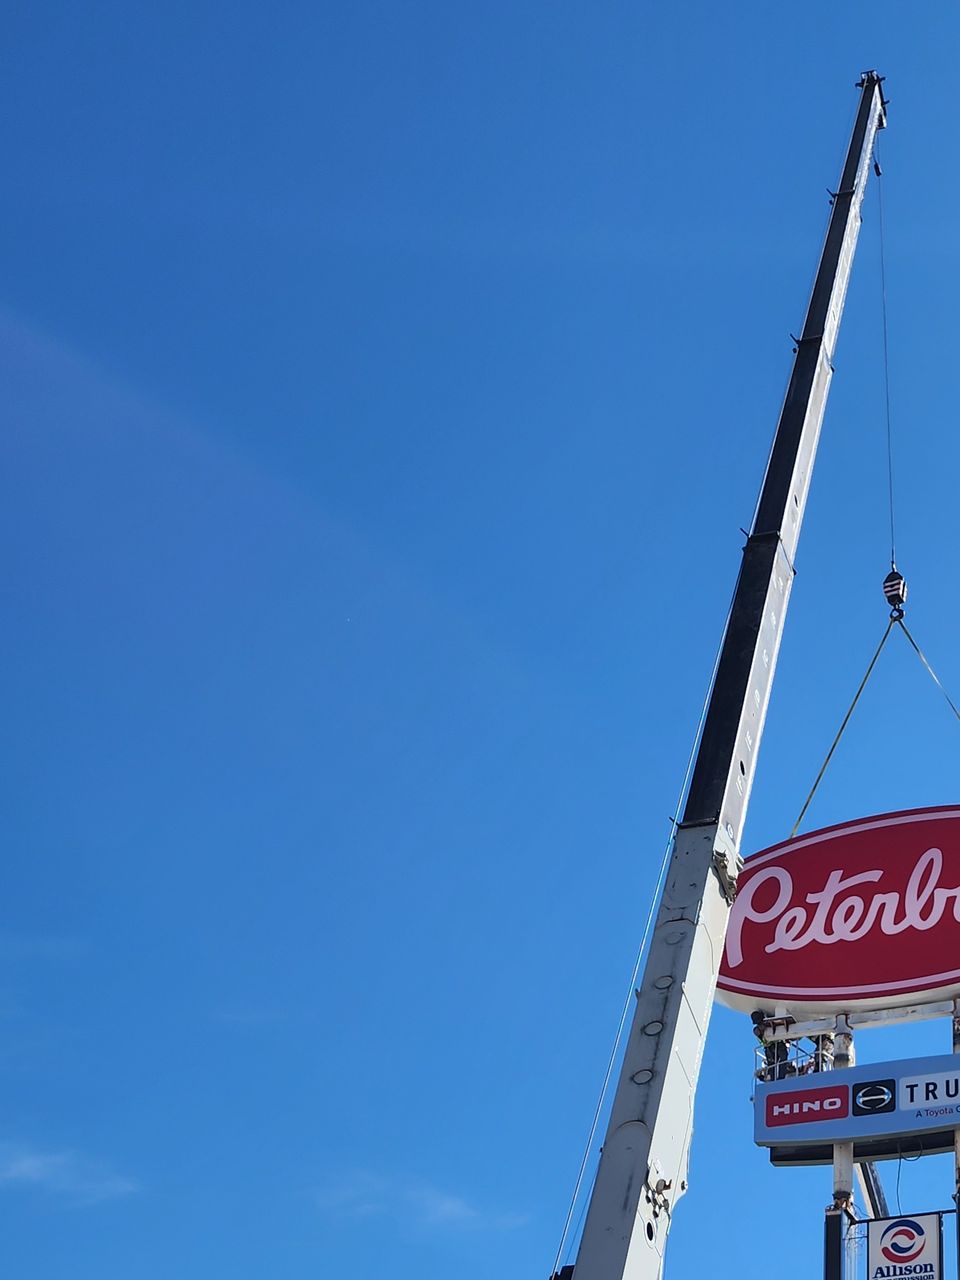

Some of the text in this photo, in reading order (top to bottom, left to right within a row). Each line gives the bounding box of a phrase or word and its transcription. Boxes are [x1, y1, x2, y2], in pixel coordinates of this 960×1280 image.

[773, 1098, 842, 1116] HINO
[915, 1110, 923, 1119] A
[925, 1107, 954, 1118] Toyota
[872, 1263, 935, 1280] Allison
